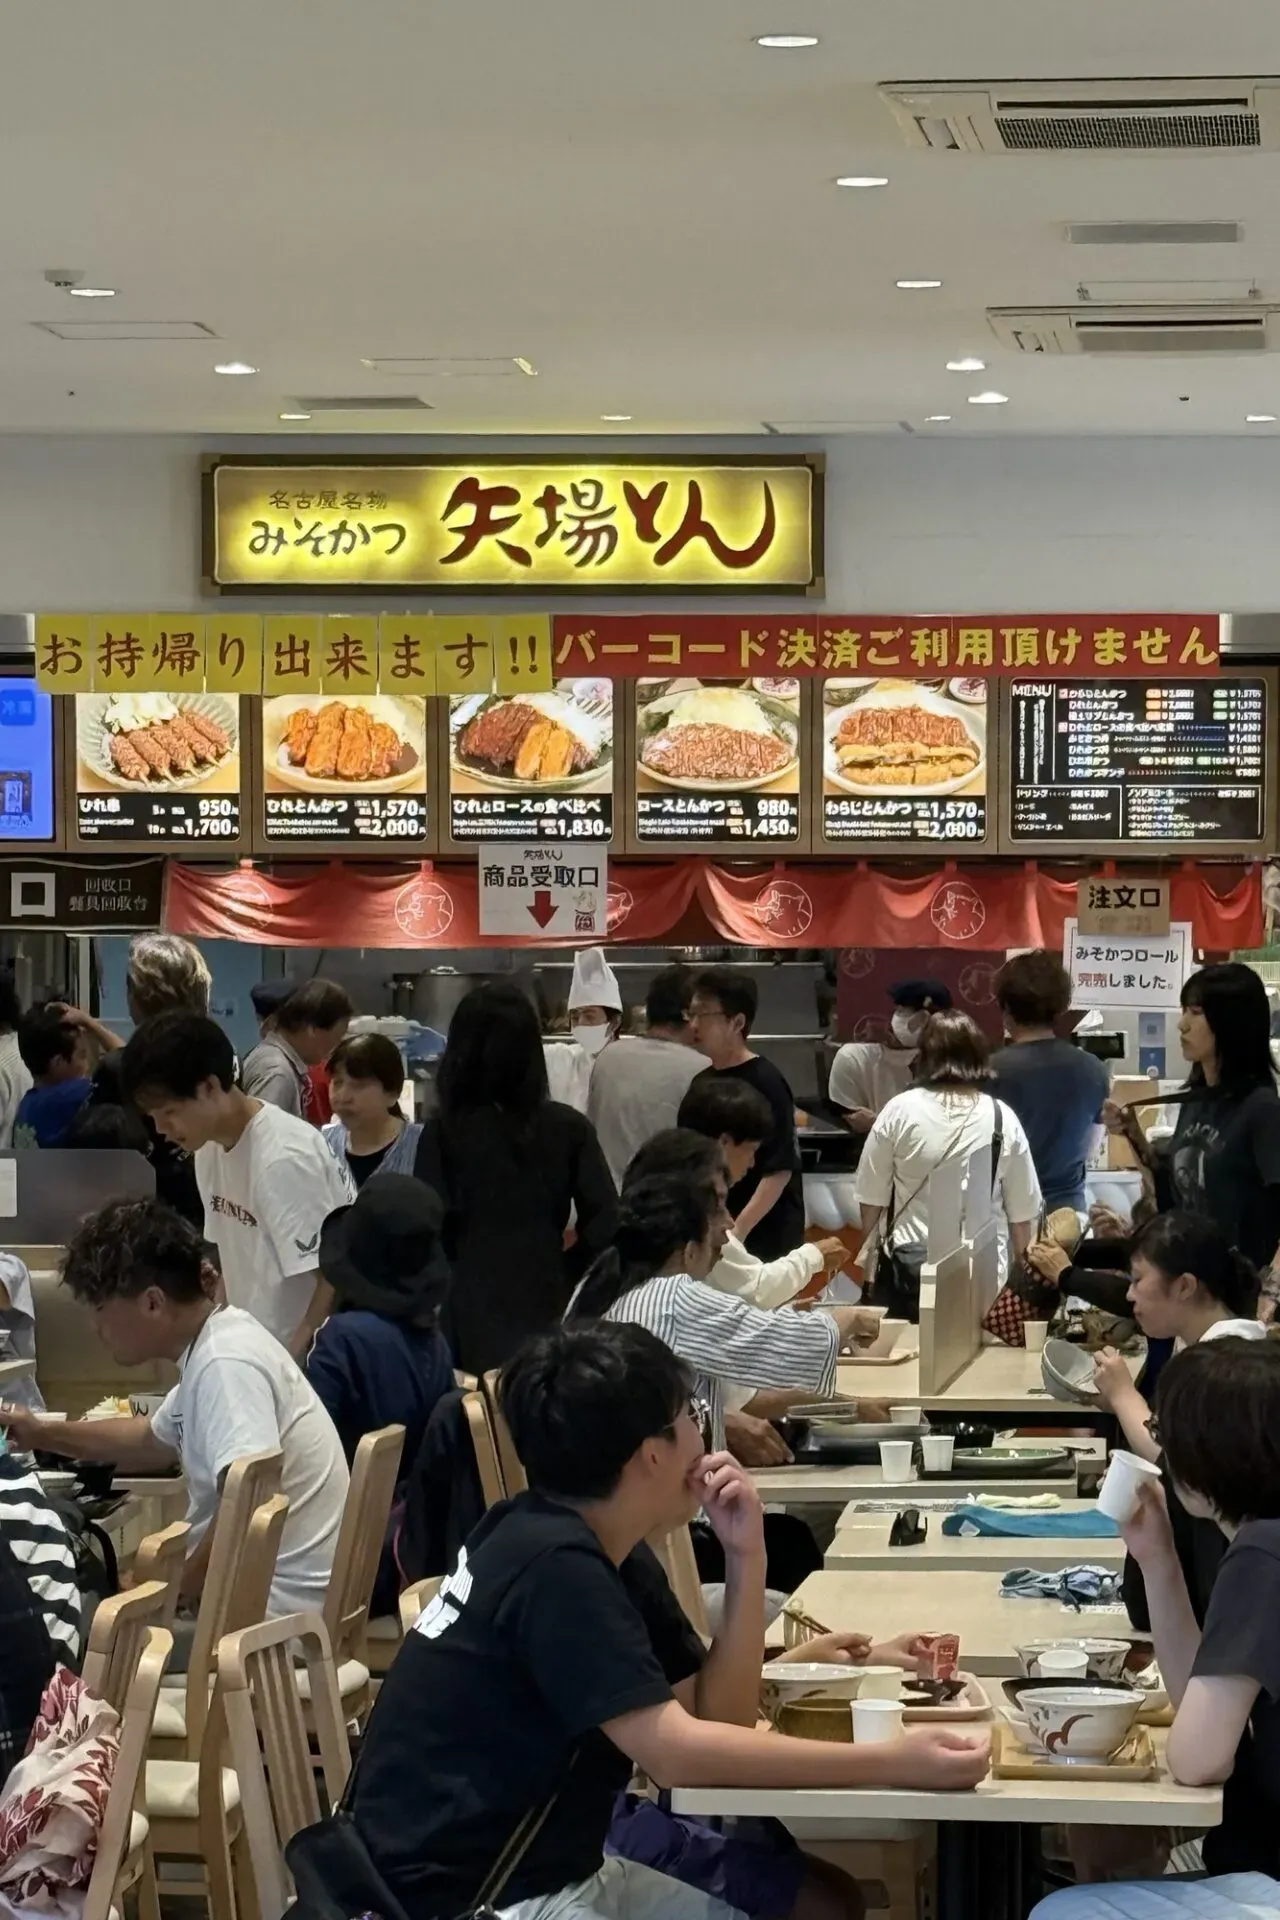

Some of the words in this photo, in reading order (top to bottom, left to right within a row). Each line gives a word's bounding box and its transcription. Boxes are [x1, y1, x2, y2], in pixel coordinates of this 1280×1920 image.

[268, 489, 388, 510] 名古屋名物
[439, 476, 776, 569] 矢場とん
[248, 517, 406, 557] みそかつ
[40, 631, 538, 679] お持帰り出来ます!!
[556, 626, 1218, 668] バーコード決済ご利用頂けません
[1012, 684, 1053, 698] MENU
[266, 798, 349, 814] ひれとんかつ
[637, 798, 727, 814] ロースとんかつ
[825, 800, 913, 816] わらじとんかつ
[483, 865, 599, 888] 商品受取口
[1088, 885, 1161, 909] 注文口
[1076, 947, 1179, 963] みそかつロール
